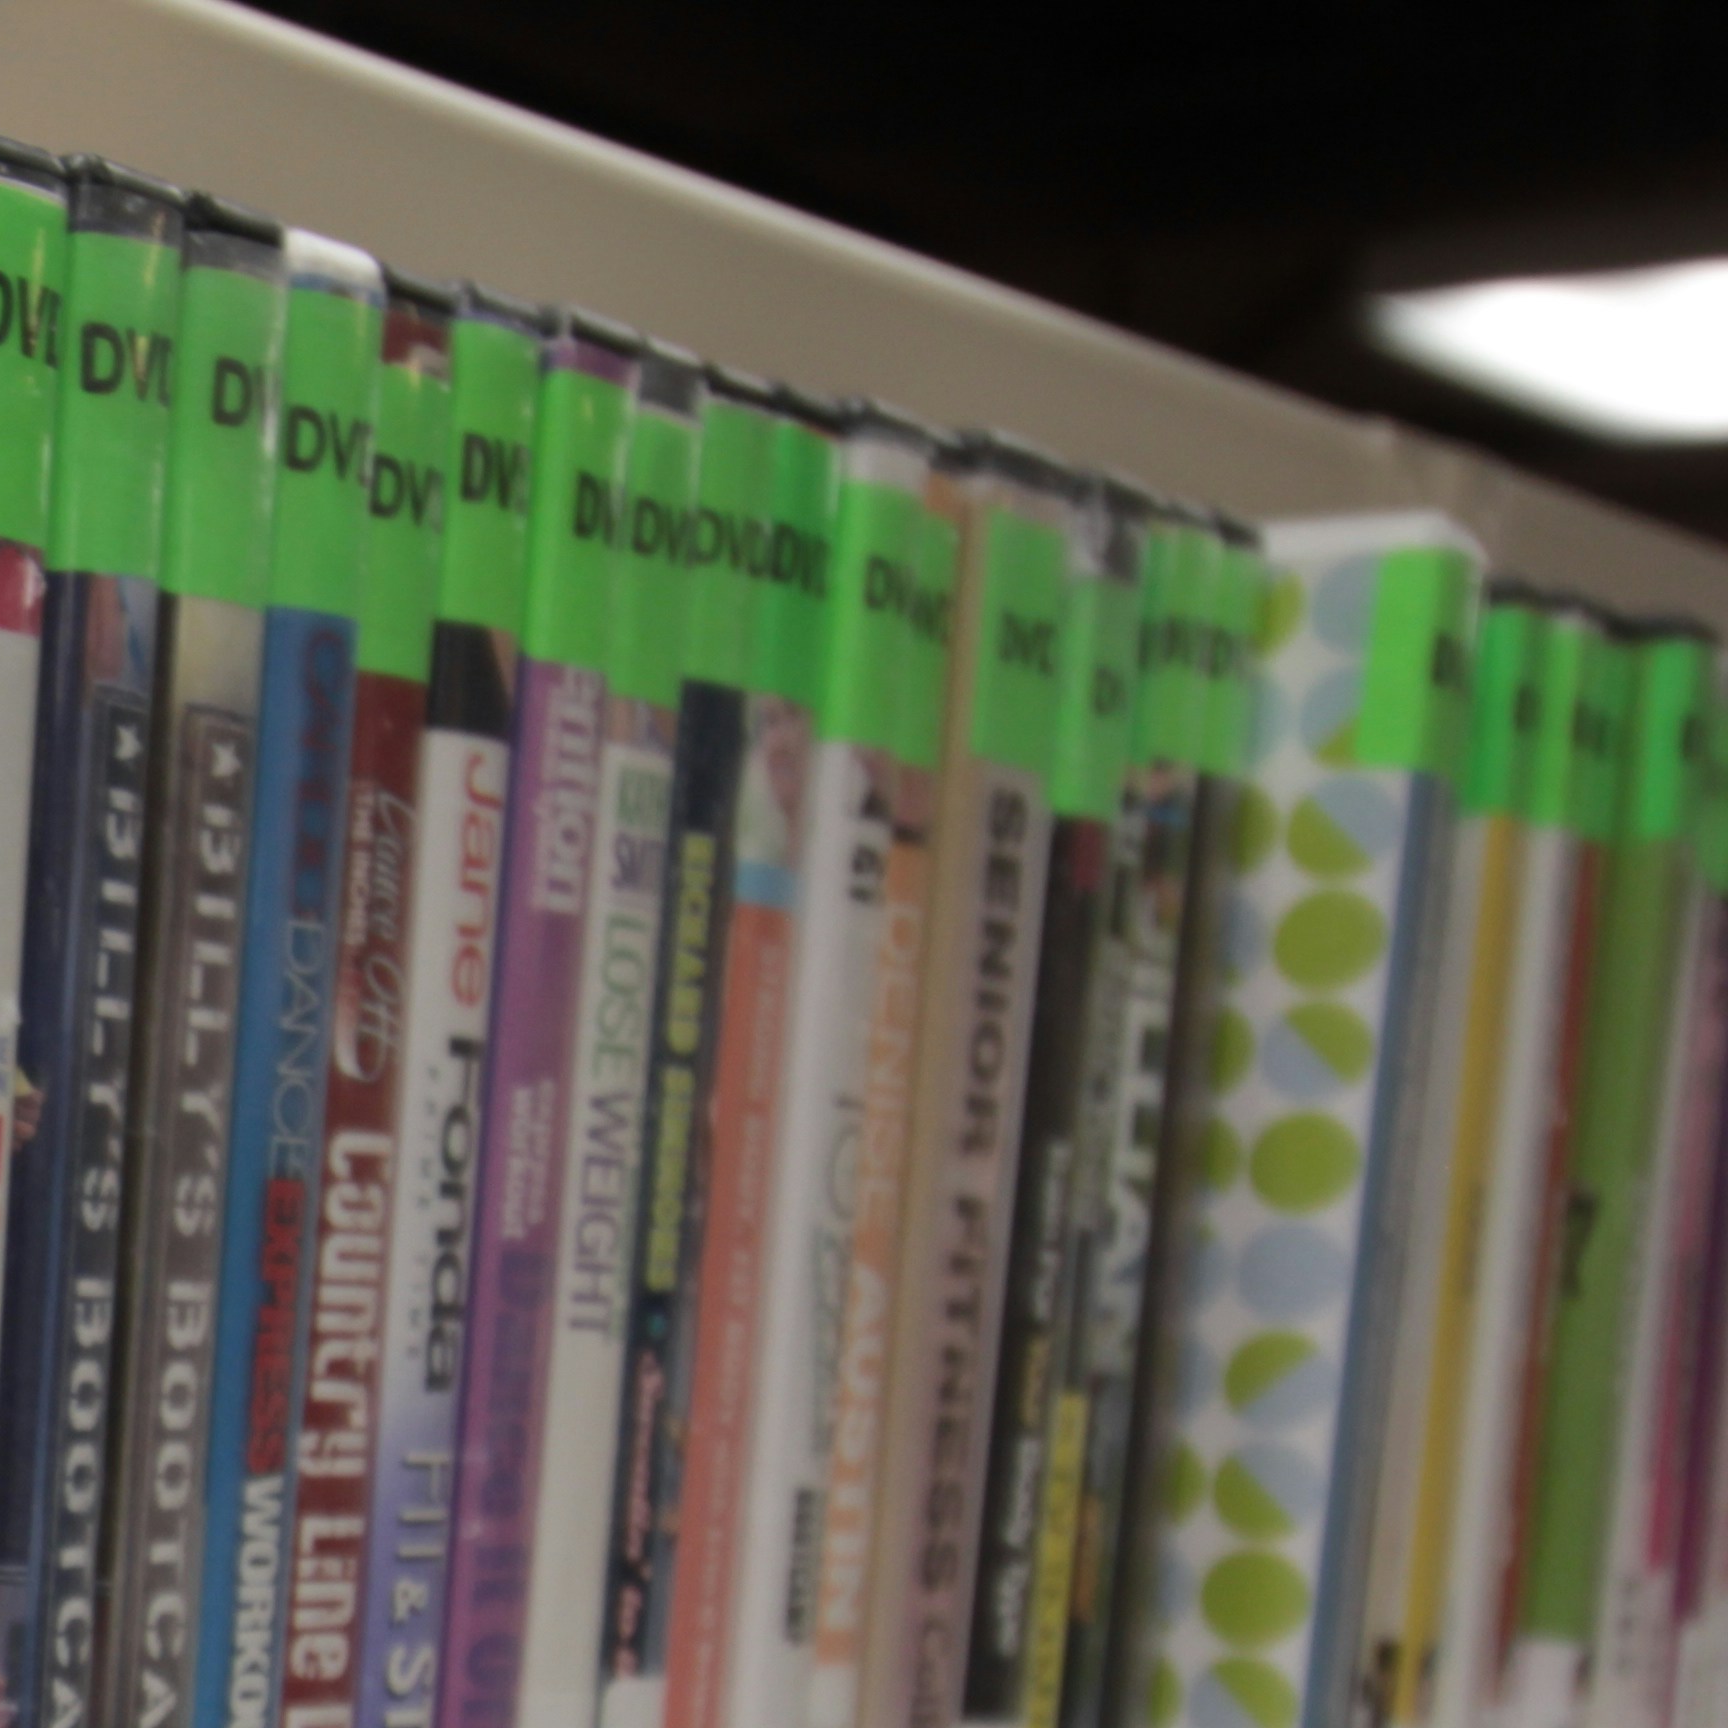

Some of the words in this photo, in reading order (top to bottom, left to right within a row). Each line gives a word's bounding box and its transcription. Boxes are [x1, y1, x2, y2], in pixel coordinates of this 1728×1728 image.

[174, 804, 240, 1238] BILLY'S
[270, 919, 327, 1176] DANCE
[452, 750, 505, 1008] Jane
[594, 908, 648, 1079] LOSE
[962, 791, 1020, 1152] SENIOR
[297, 1130, 394, 1478] Country
[428, 1038, 484, 1391] Fonda
[569, 1087, 644, 1337] WEIGHT
[922, 1197, 989, 1594] FITNESS
